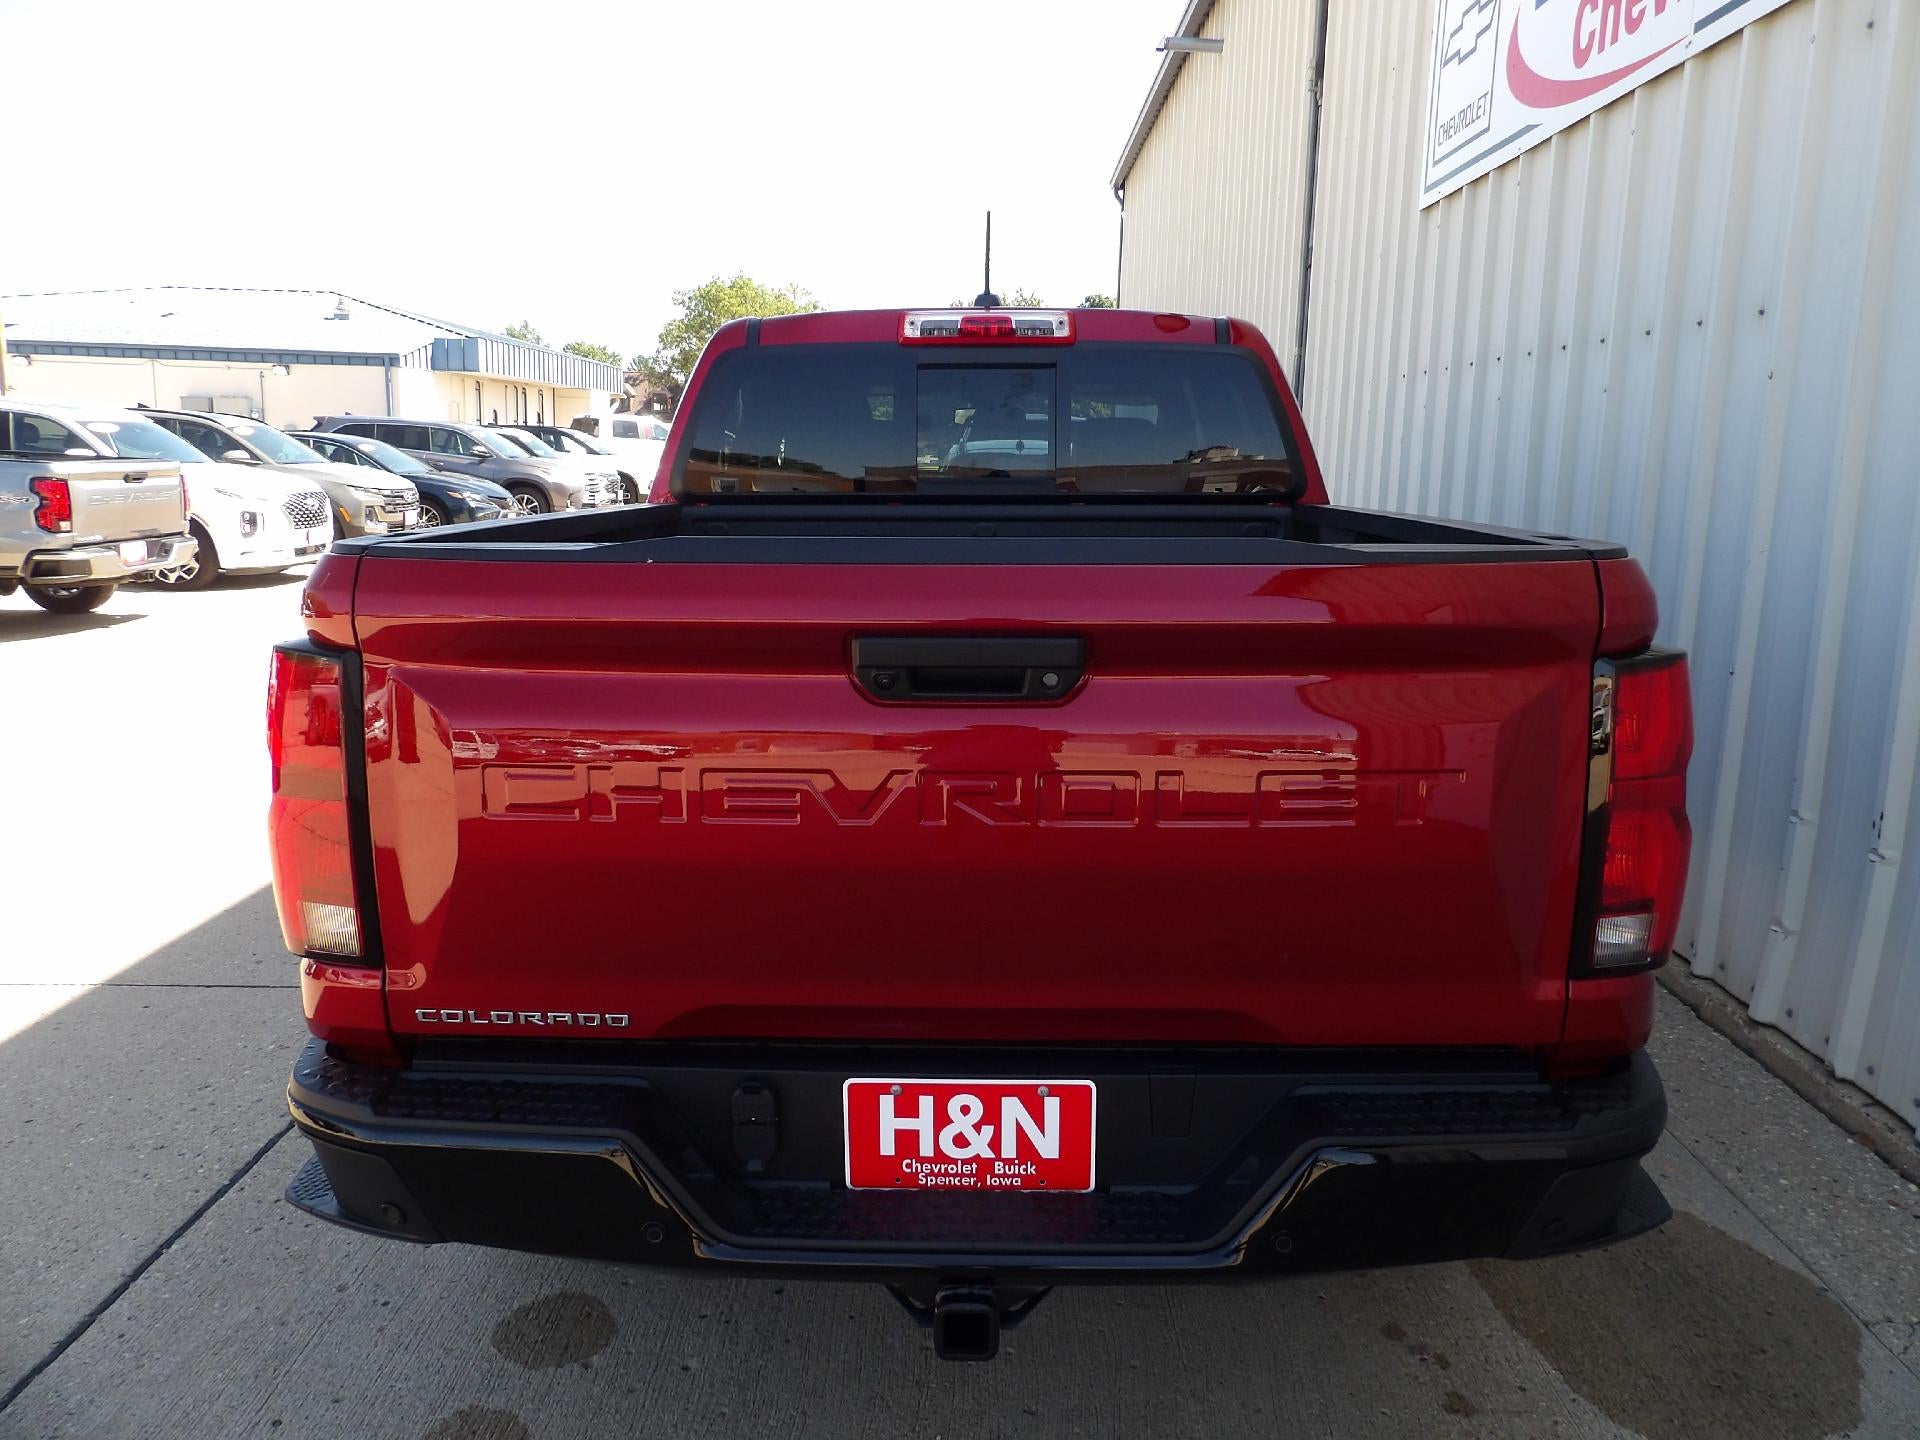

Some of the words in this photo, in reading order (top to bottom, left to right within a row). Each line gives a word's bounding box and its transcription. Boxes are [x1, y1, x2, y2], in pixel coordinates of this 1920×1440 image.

[1438, 90, 1489, 147] CHEVROLET
[480, 762, 1467, 830] CHEVROLET
[415, 1009, 630, 1027] COLORADO
[879, 1094, 1060, 1159] H&N
[902, 1159, 978, 1175] Chevrolet
[993, 1160, 1037, 1175] Buick
[918, 1172, 982, 1188] Spencer,
[986, 1175, 1021, 1186] Iowa
